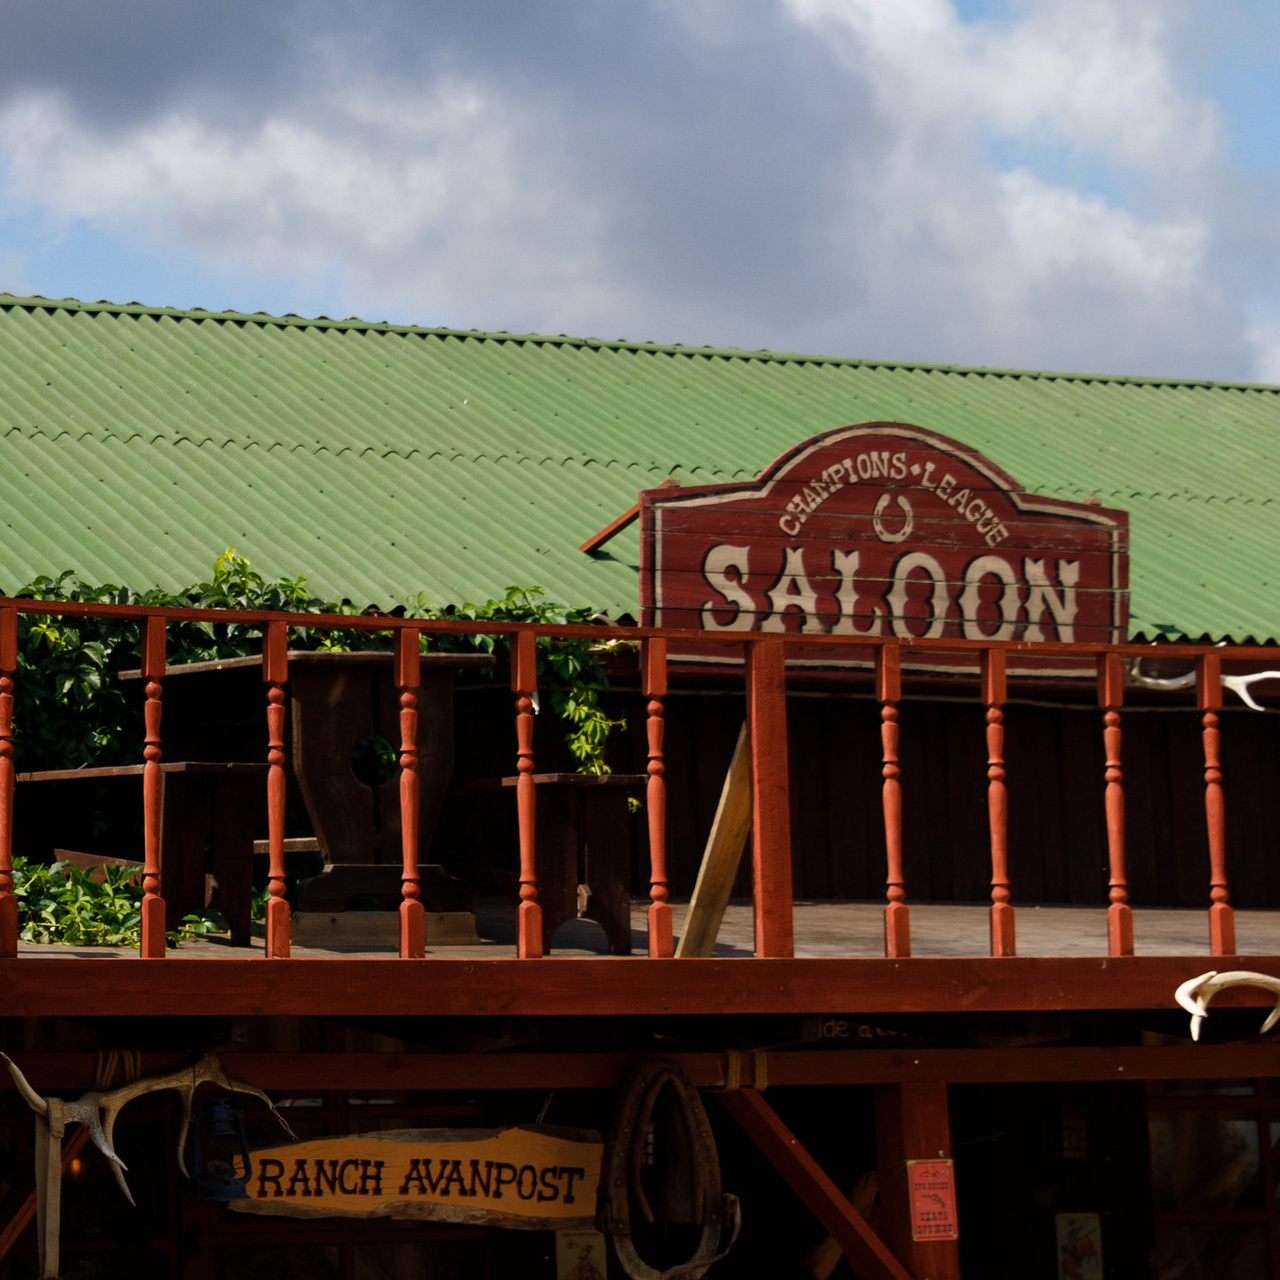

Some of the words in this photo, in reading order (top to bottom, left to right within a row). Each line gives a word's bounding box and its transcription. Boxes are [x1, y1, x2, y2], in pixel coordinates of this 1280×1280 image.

[779, 451, 906, 536] CHAMPIONS
[921, 461, 1009, 547] LEAGUE
[702, 544, 1080, 642] SALOON
[257, 1158, 385, 1198] RANCH
[399, 1158, 585, 1204] AVANPOST
